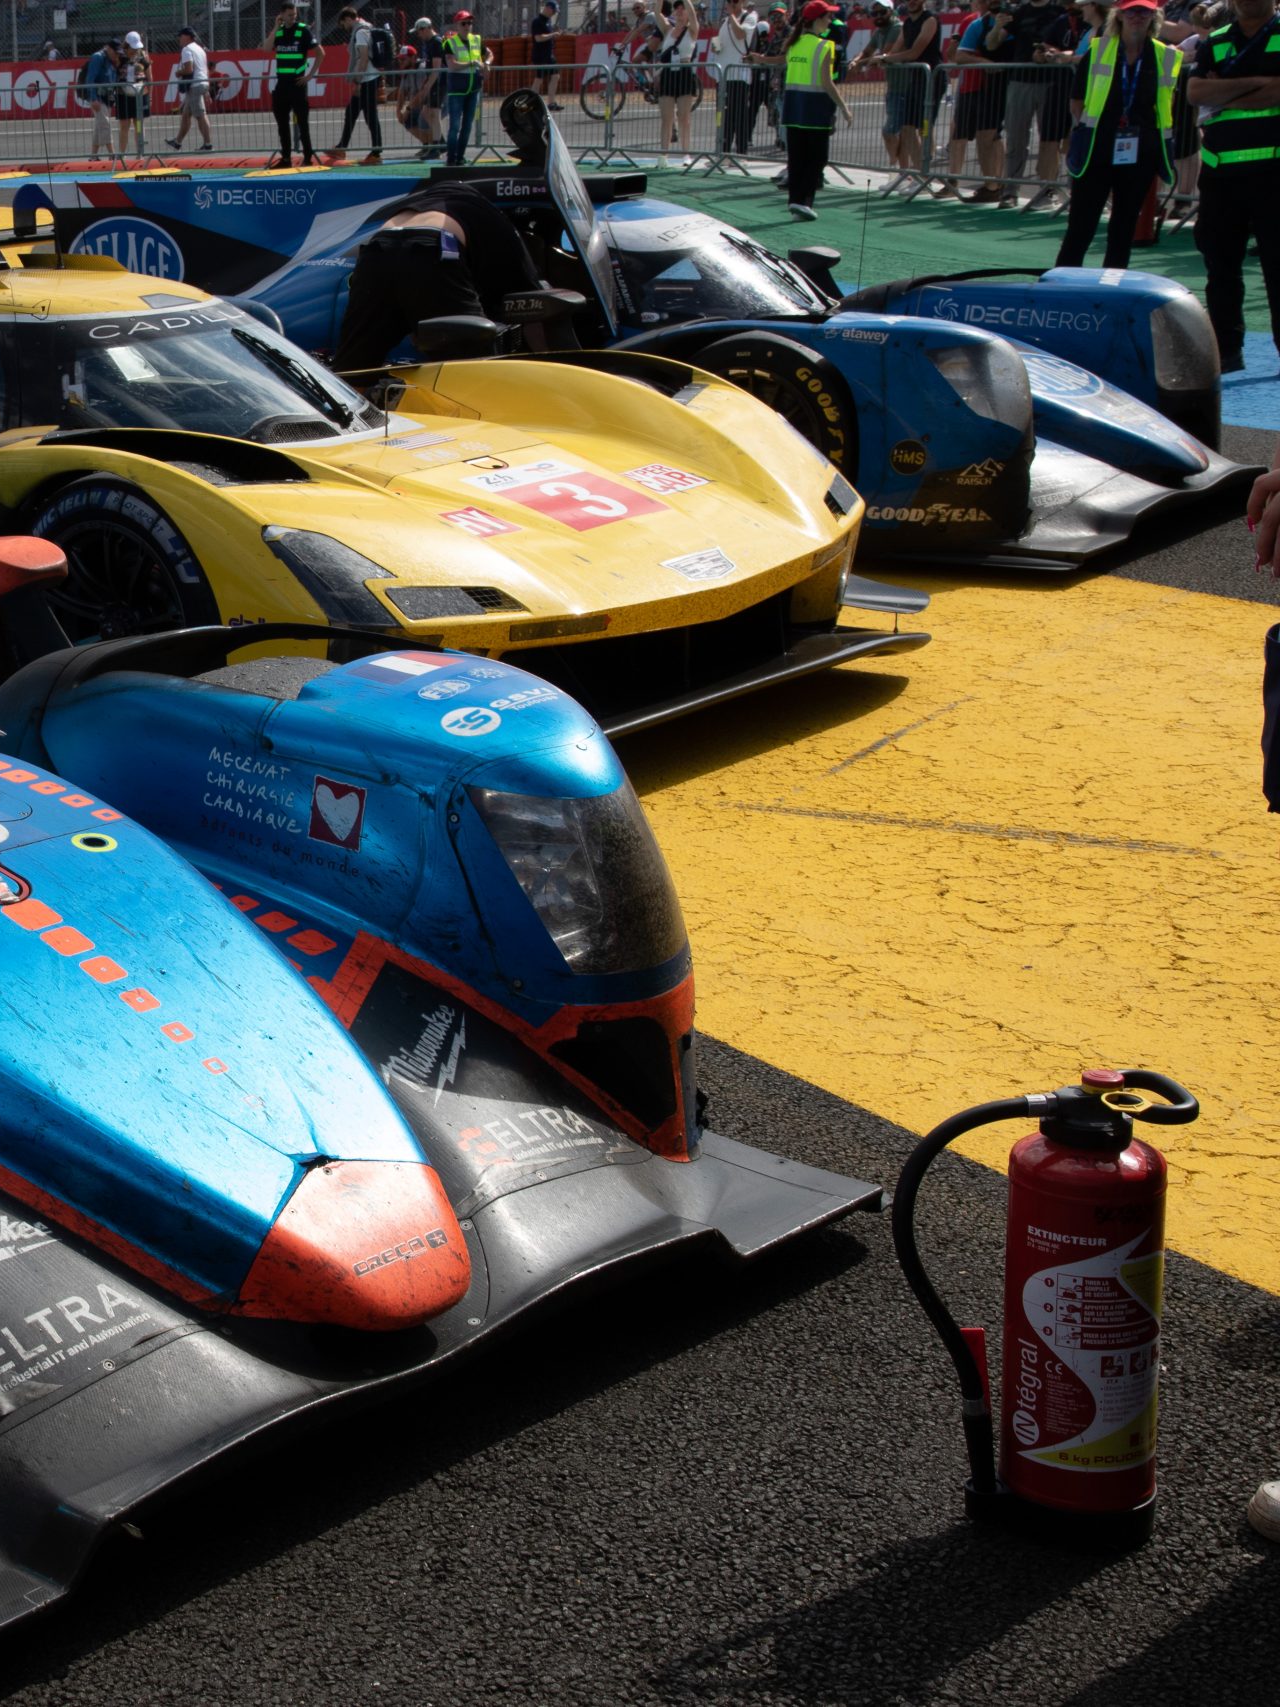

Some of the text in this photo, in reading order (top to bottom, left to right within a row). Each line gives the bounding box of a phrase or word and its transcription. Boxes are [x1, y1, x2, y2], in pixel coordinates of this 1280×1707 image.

[496, 181, 530, 197] Eden
[841, 327, 890, 344] atawey
[891, 449, 926, 466] HMS
[955, 473, 993, 486] RAISCH
[538, 481, 629, 518] 3
[447, 509, 511, 536] HY
[865, 503, 993, 527] GOODYEAR
[419, 679, 468, 700] FIA
[300, 851, 360, 877] monde
[379, 1004, 457, 1092] Milwaukee
[484, 1105, 595, 1149] ELTRA
[1027, 1224, 1108, 1247] EXTINCTEUR
[353, 1236, 426, 1278] ORECA
[53, 1350, 67, 1366] IT
[66, 1338, 90, 1357] and
[88, 1311, 151, 1346] Automation
[1073, 1454, 1090, 1465] kg
